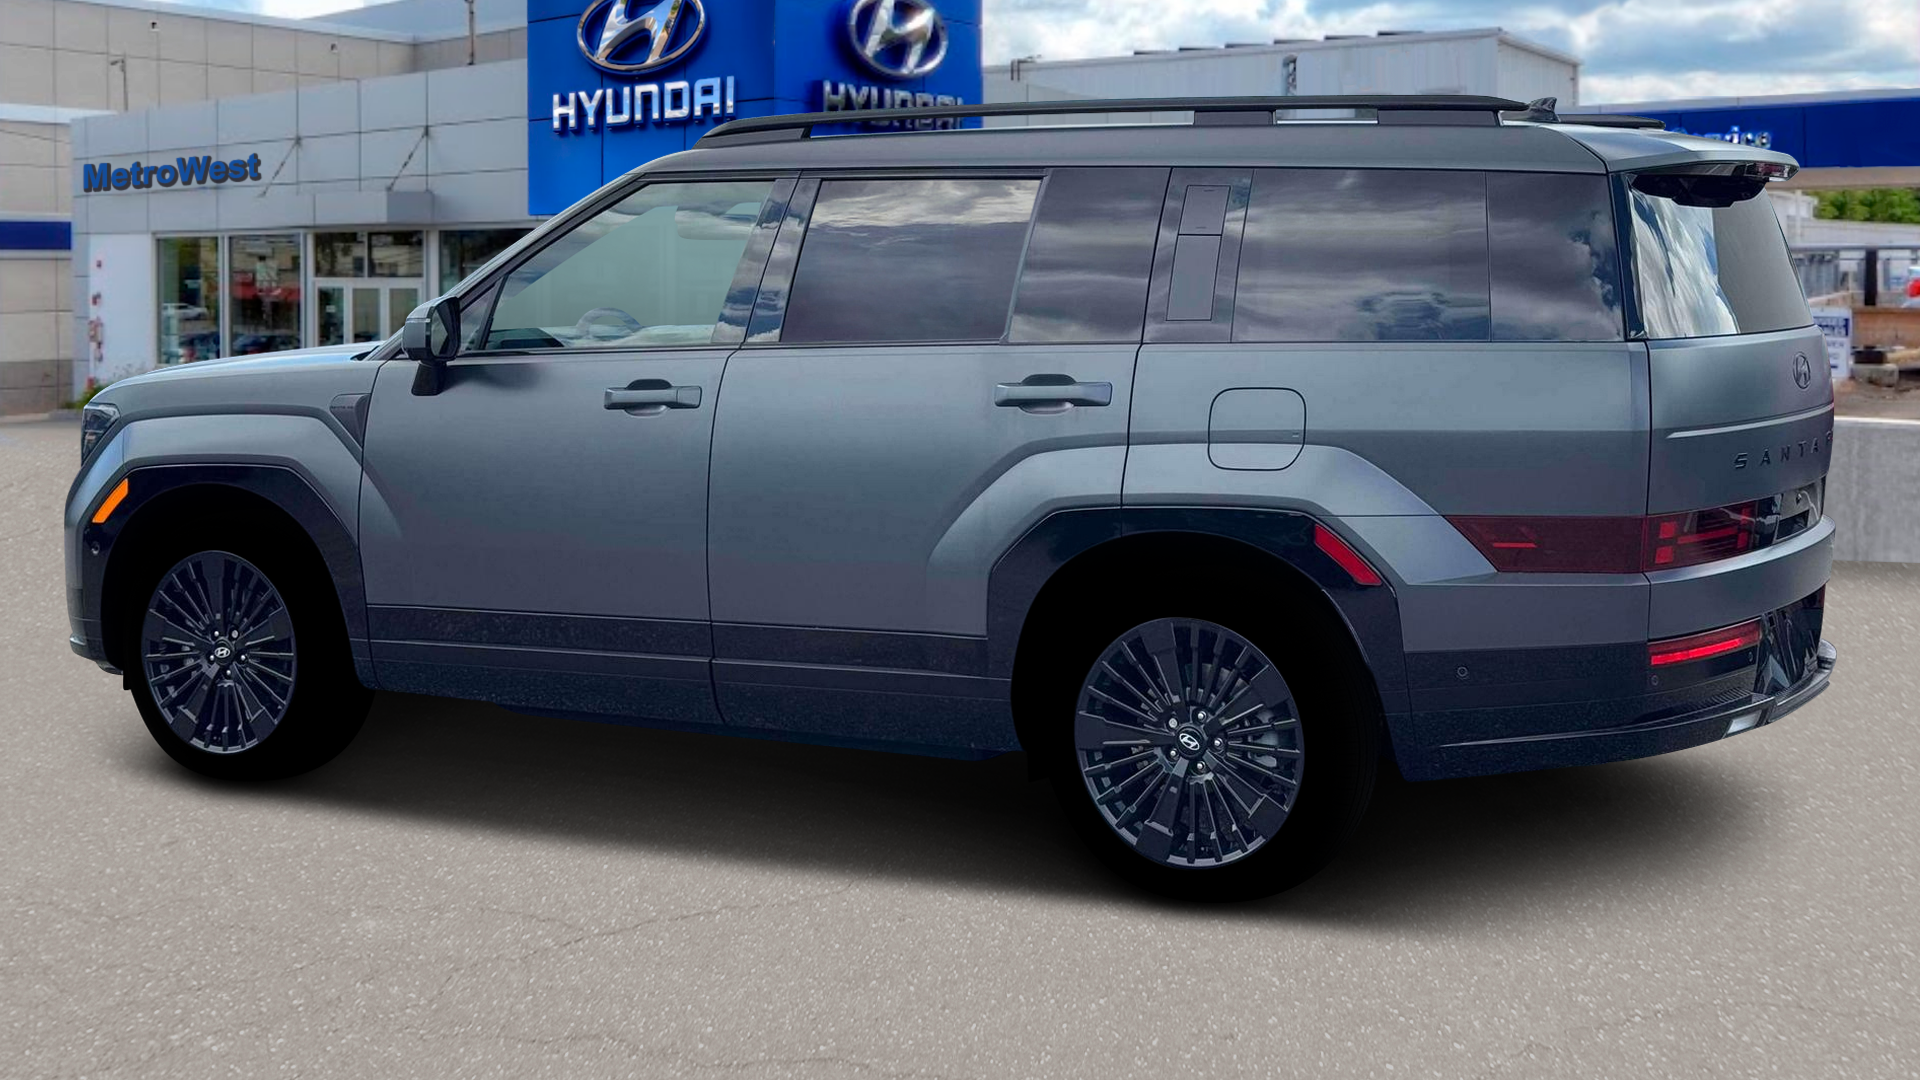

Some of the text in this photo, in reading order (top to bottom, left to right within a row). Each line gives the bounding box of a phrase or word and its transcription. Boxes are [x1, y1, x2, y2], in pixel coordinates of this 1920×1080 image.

[553, 75, 736, 130] HYUNDAI
[823, 80, 964, 129] HYUNDAI
[84, 153, 262, 193] MetroWest
[1734, 437, 1819, 469] SANTA
